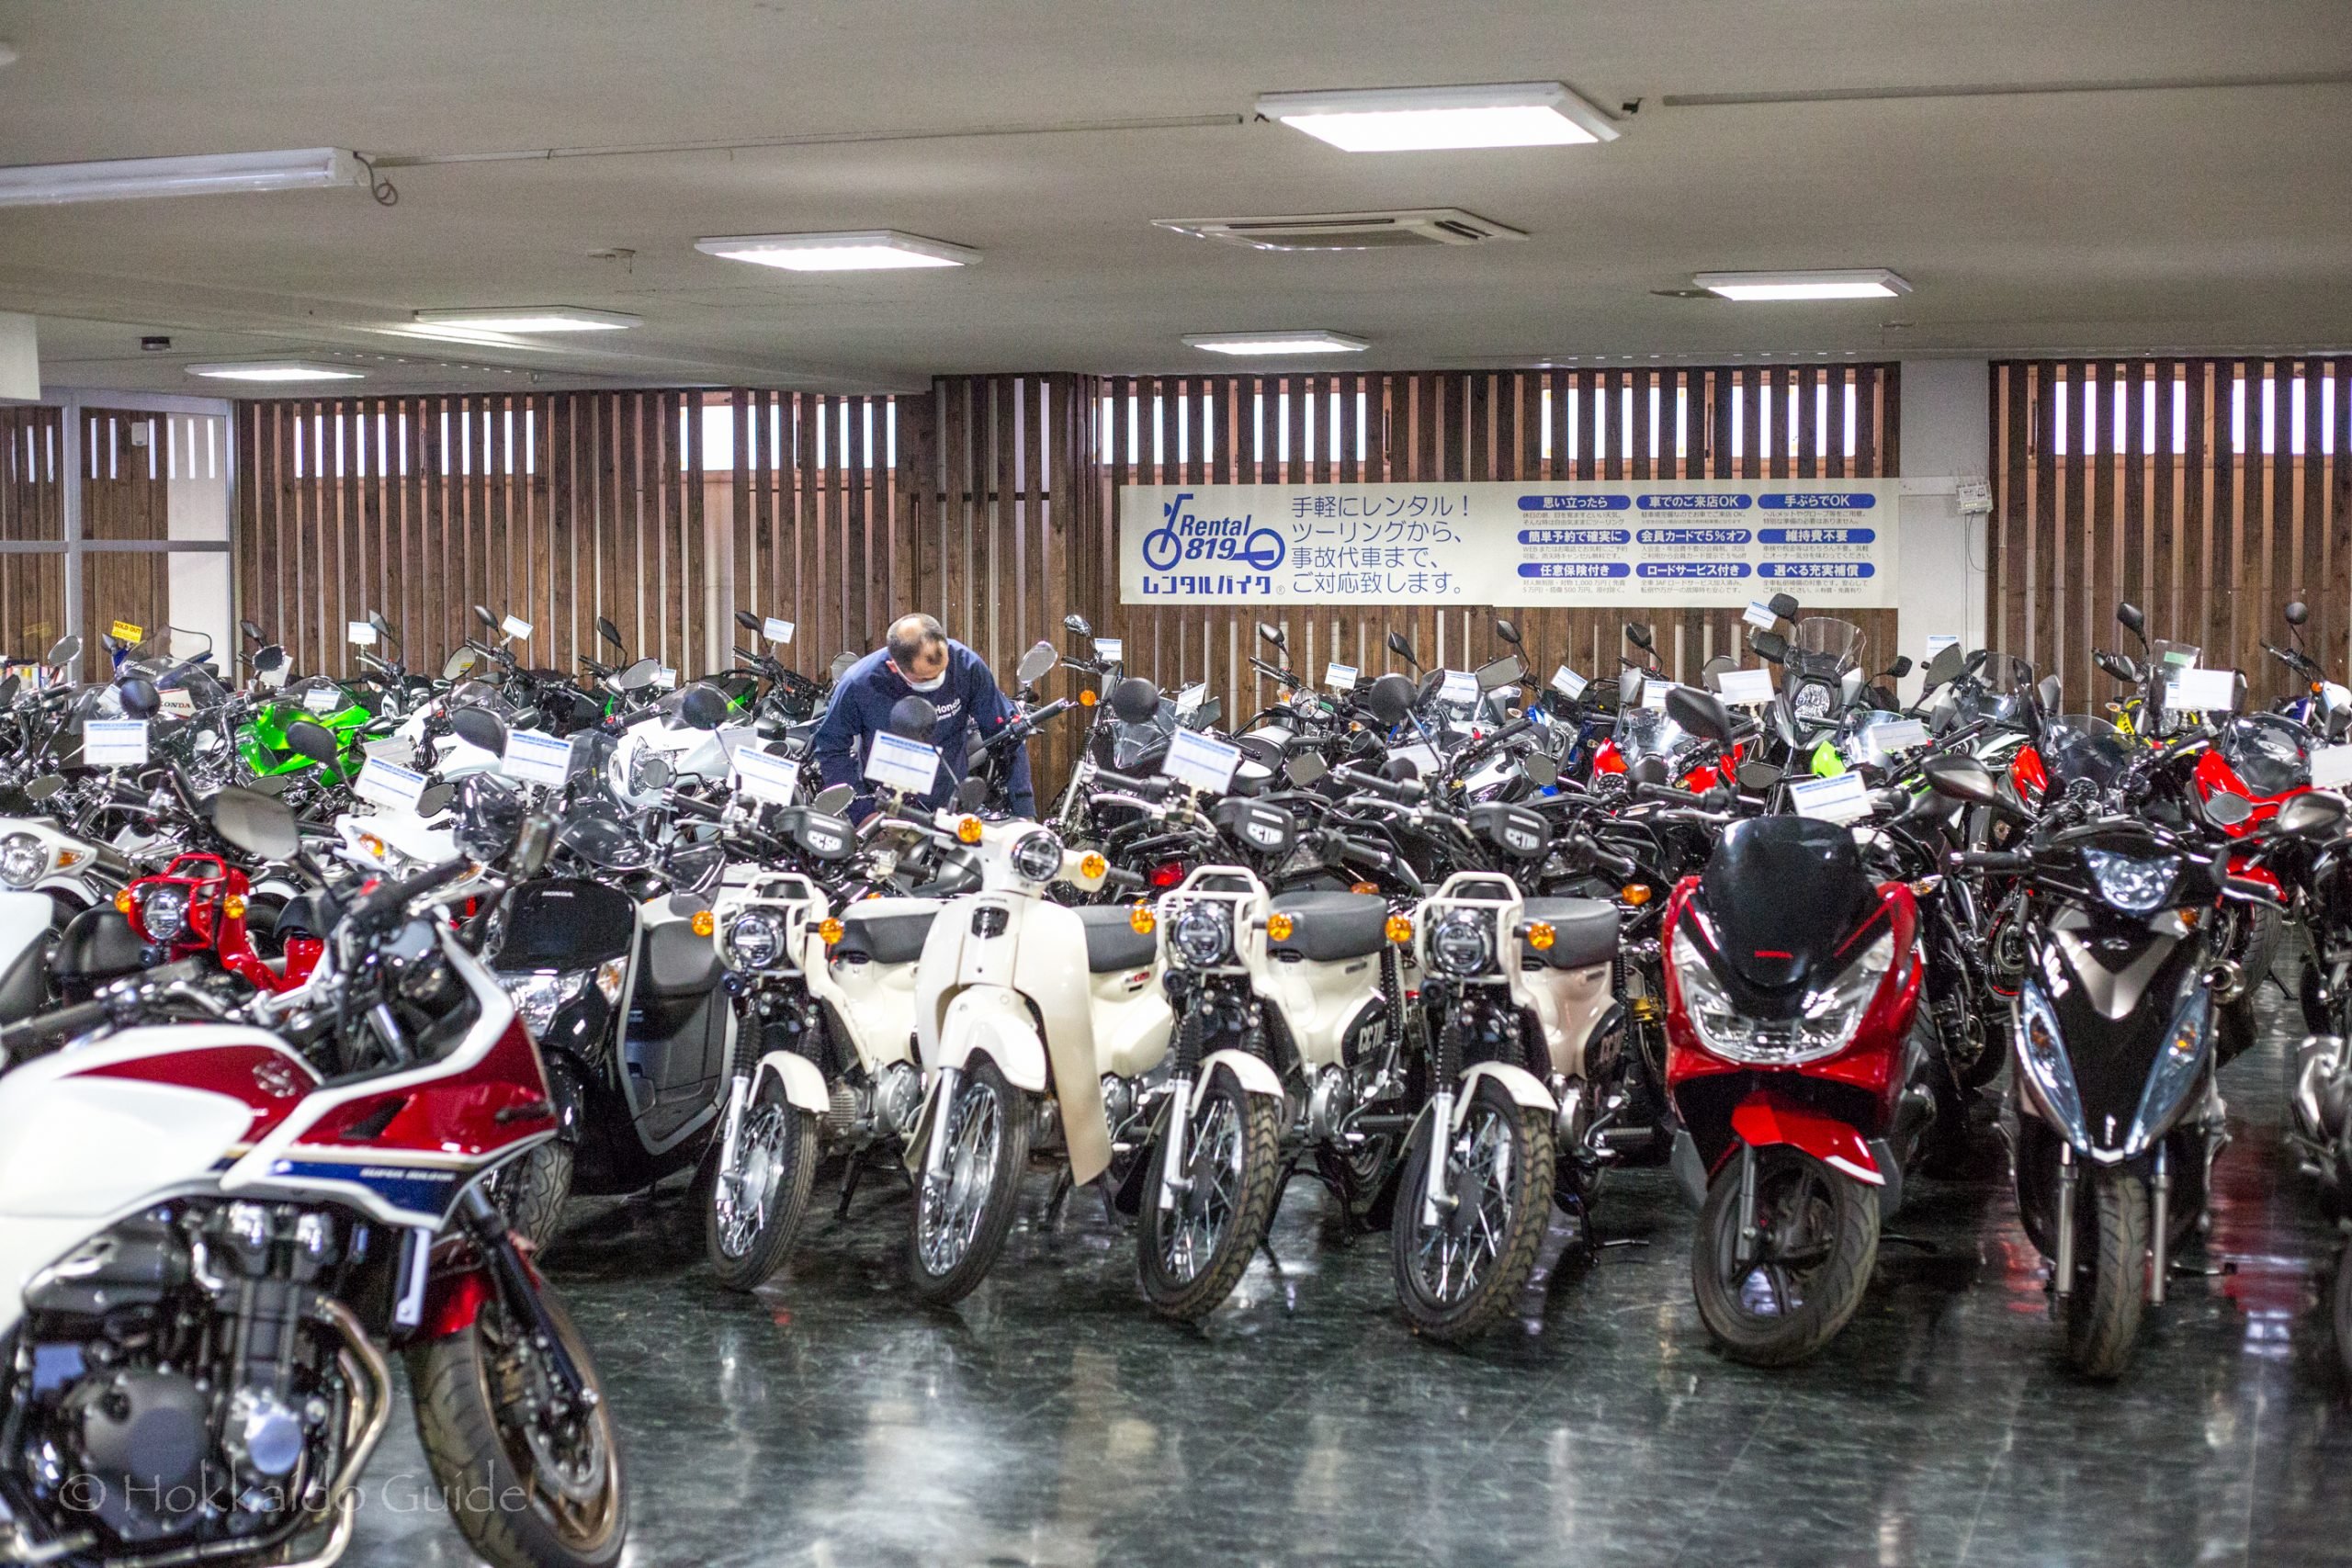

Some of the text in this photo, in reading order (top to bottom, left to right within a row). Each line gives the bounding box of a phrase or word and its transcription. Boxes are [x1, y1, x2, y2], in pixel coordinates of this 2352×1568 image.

[1543, 497, 1608, 508] 思い立ったら
[1648, 496, 1739, 508] 車でのご来店OK
[1784, 495, 1850, 507] 手ぶらでOK
[1180, 514, 1252, 536] Rental
[1292, 520, 1463, 544] ツーリングから、
[1528, 530, 1623, 543] 簡単予約で確実に
[1785, 529, 1849, 542] 維持費不要
[1184, 537, 1237, 560] 819
[1292, 547, 1439, 569] 事故代車まで、
[1540, 564, 1610, 577] 任意保険付き
[1647, 564, 1740, 577] ロードサービス付き
[1774, 564, 1859, 577] 選べる充実補償
[1143, 575, 1272, 594] レンタルバイク
[1292, 571, 1463, 594] ご対応致します。
